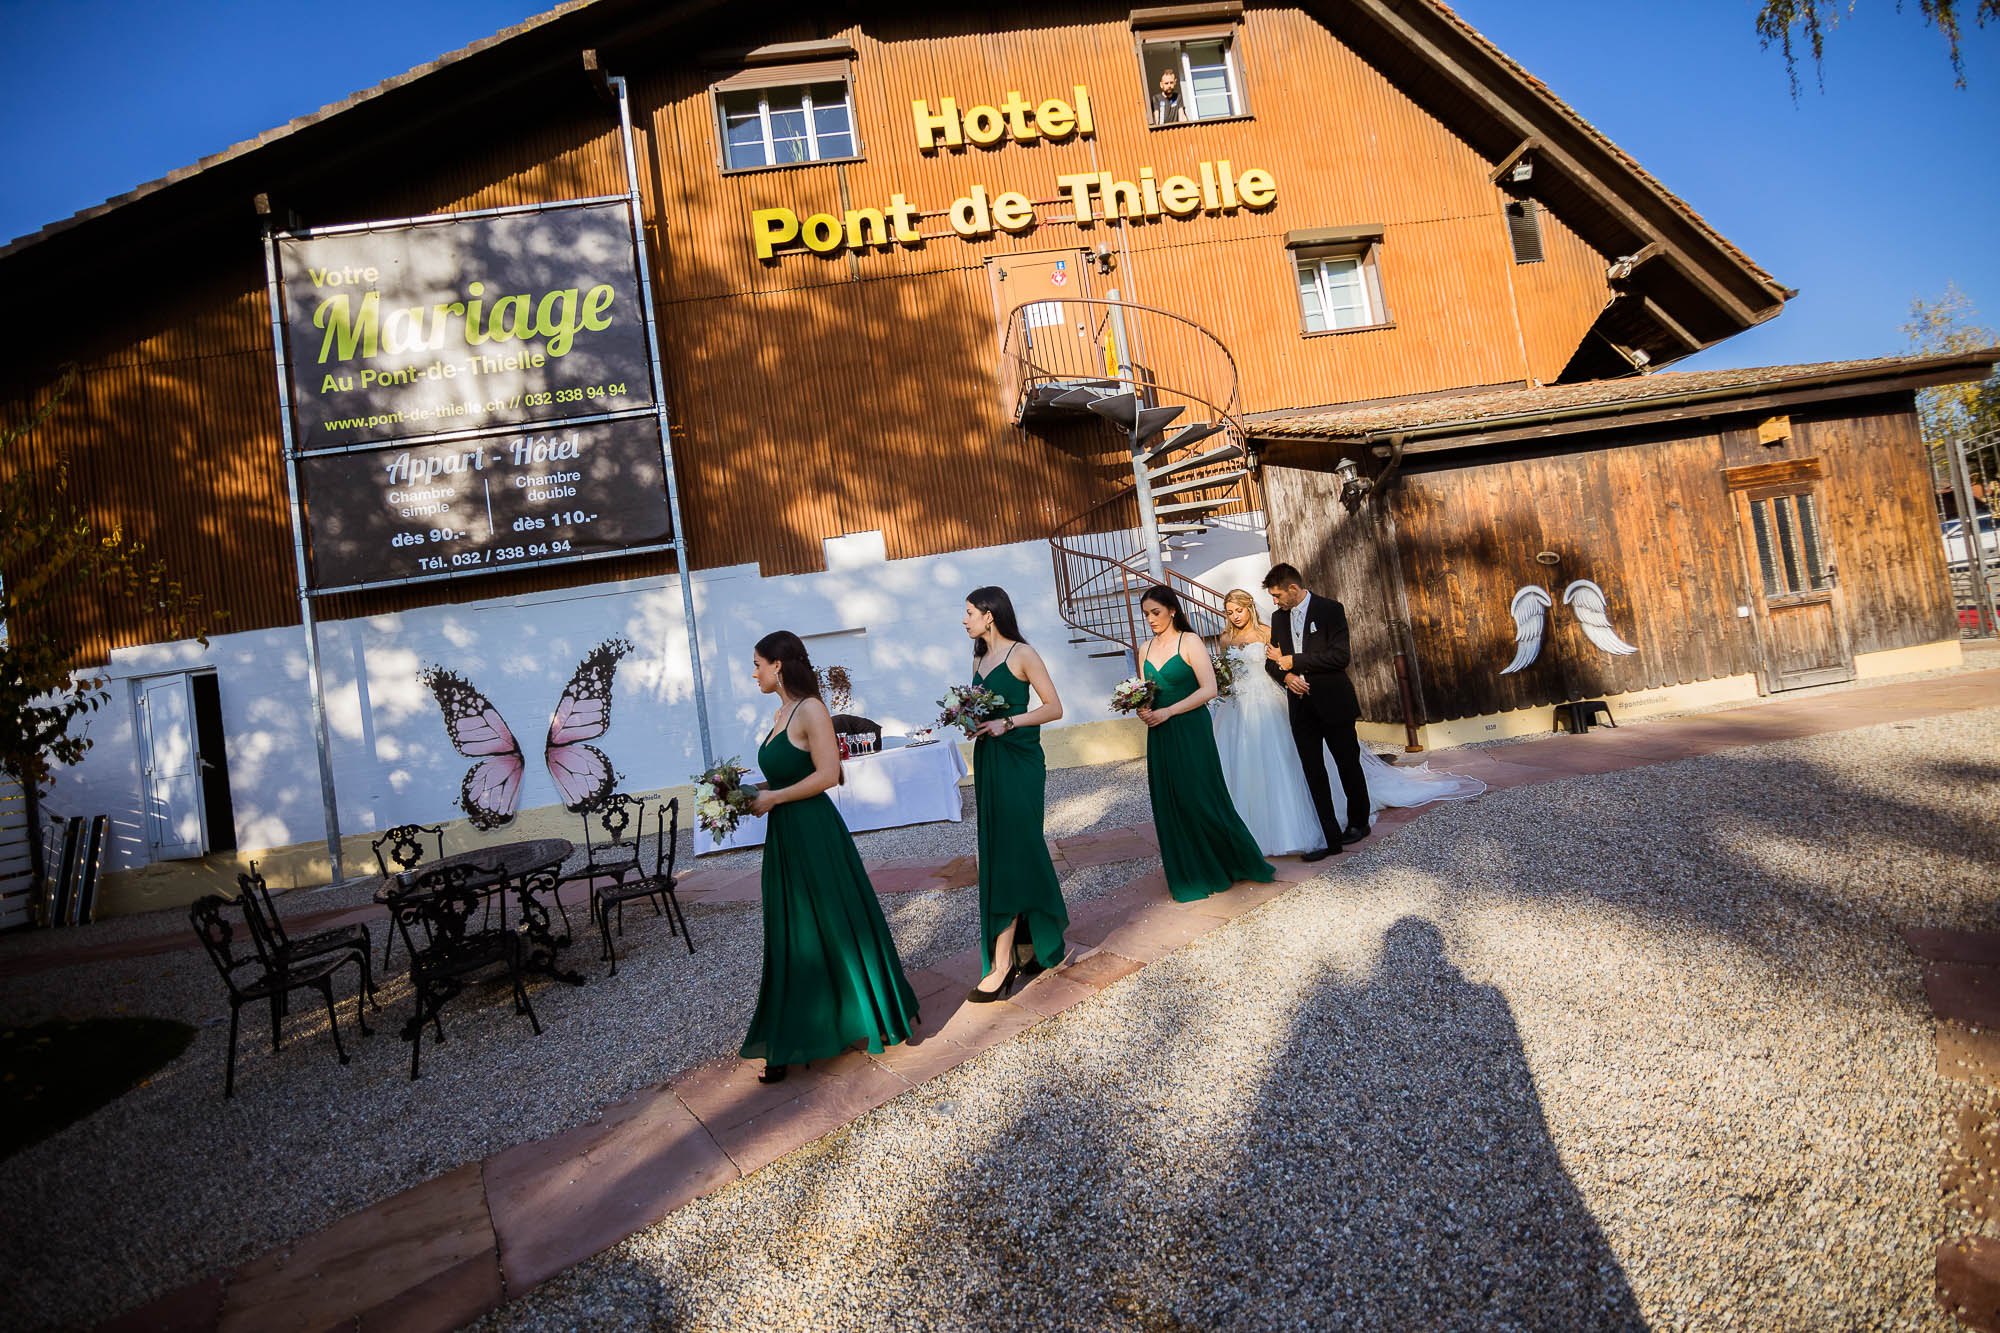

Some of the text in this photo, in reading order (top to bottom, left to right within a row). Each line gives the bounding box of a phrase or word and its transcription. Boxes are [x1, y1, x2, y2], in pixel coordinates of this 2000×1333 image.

[911, 85, 1094, 152] Hotel
[752, 159, 1277, 260] Pont de Thielle
[308, 265, 379, 288] Votre
[313, 281, 615, 364] Mariage
[321, 350, 546, 394] Au Pont-de-Thielle
[324, 382, 627, 432] www.pont-de-thielle.ch // 032 338 94 94
[386, 446, 485, 487] Appart
[509, 433, 580, 466] Hôtel
[515, 471, 581, 488] Chambre
[389, 487, 456, 504] Chambre
[527, 486, 577, 502] double
[402, 501, 450, 518] simple
[512, 510, 598, 532] dès 110.-
[391, 527, 466, 548] dès 90.-
[418, 539, 571, 571] Tél. 032 / 338 94 94
